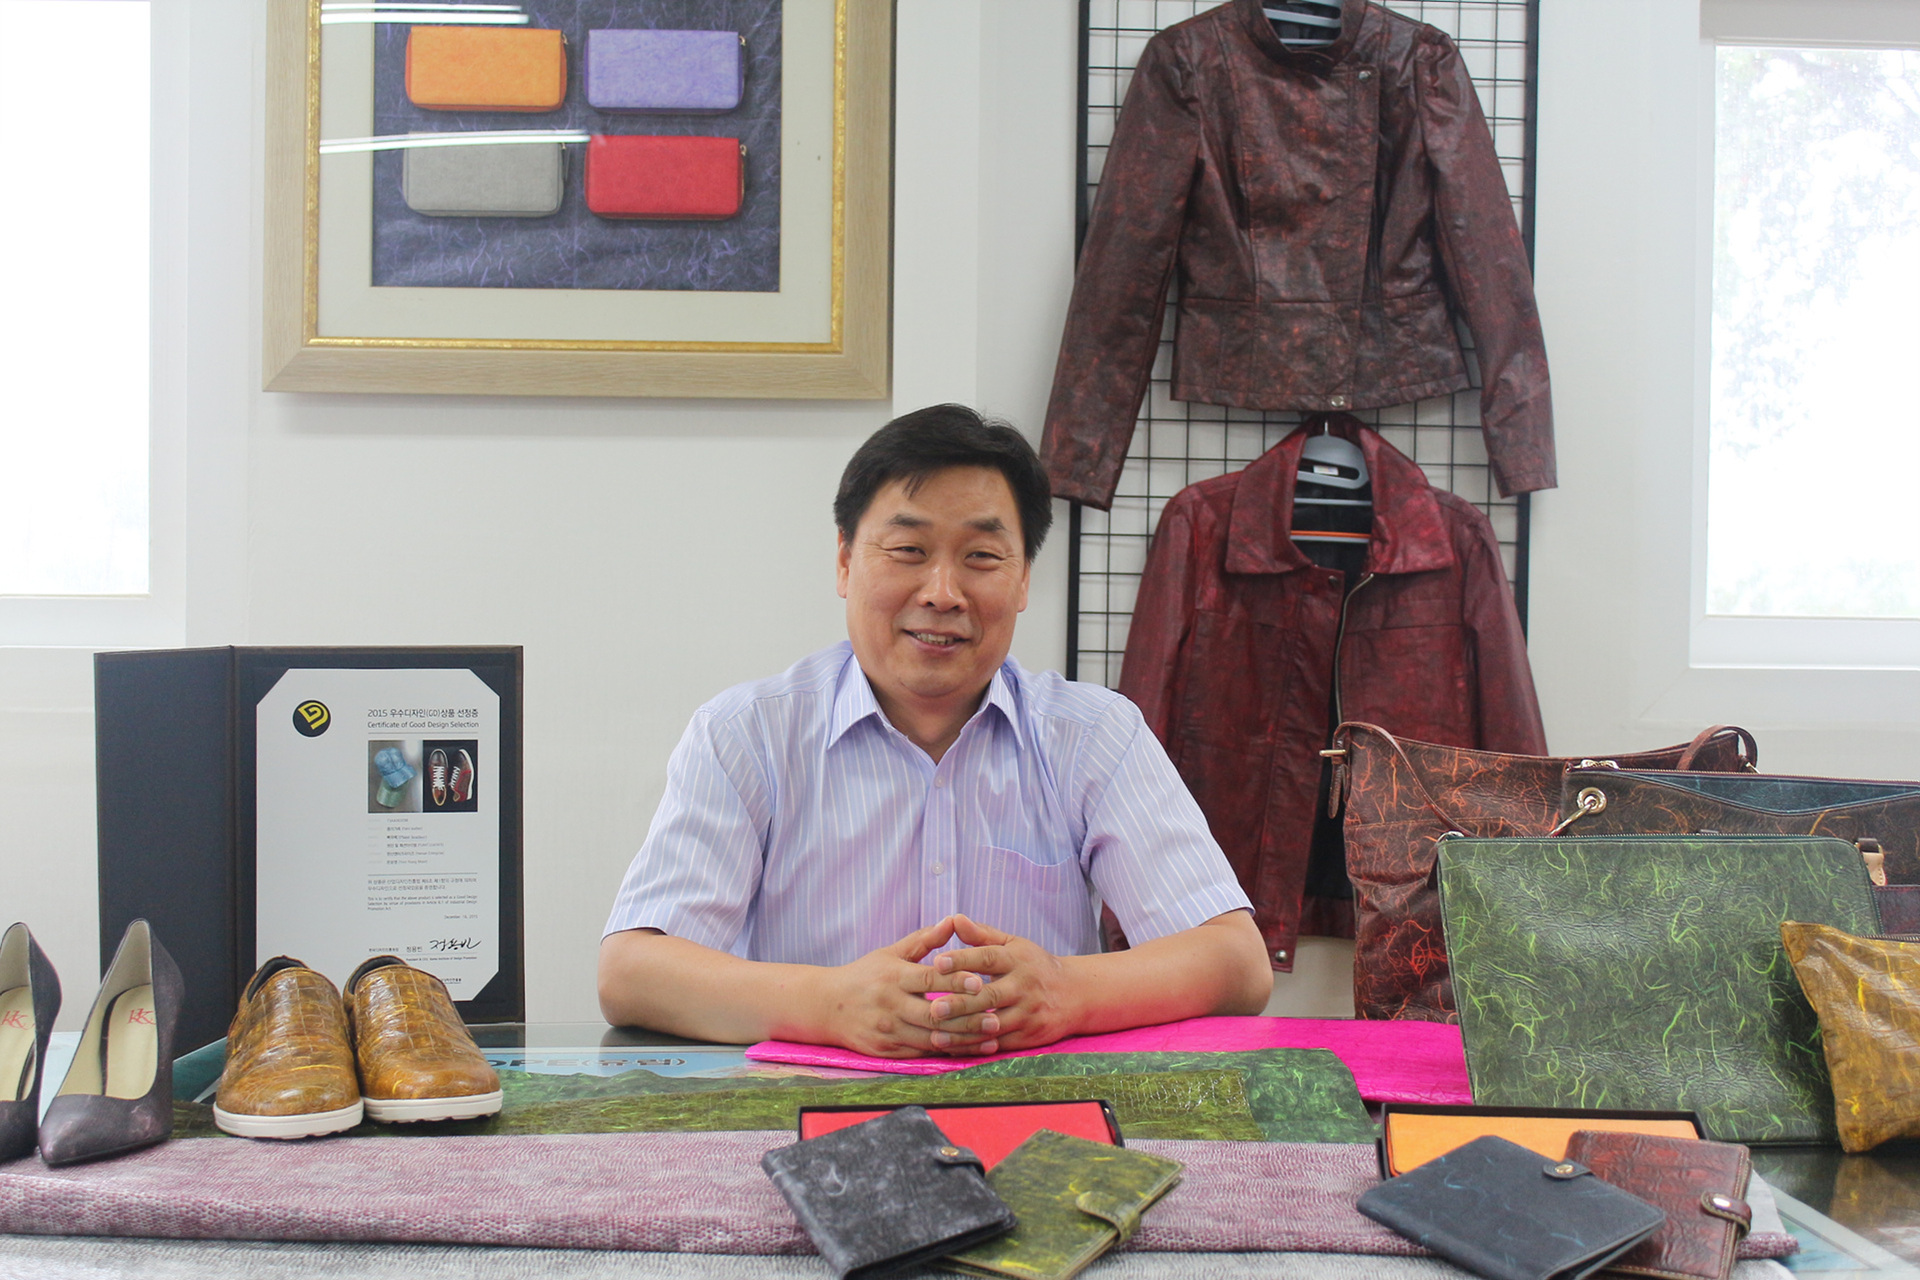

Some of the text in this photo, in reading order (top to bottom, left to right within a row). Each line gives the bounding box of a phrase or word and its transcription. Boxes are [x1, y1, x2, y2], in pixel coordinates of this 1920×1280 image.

[368, 709, 388, 718] 2015
[457, 708, 479, 718] 선정증
[367, 721, 400, 729] Certificate
[427, 721, 449, 729] Design
[450, 720, 479, 728] Selection
